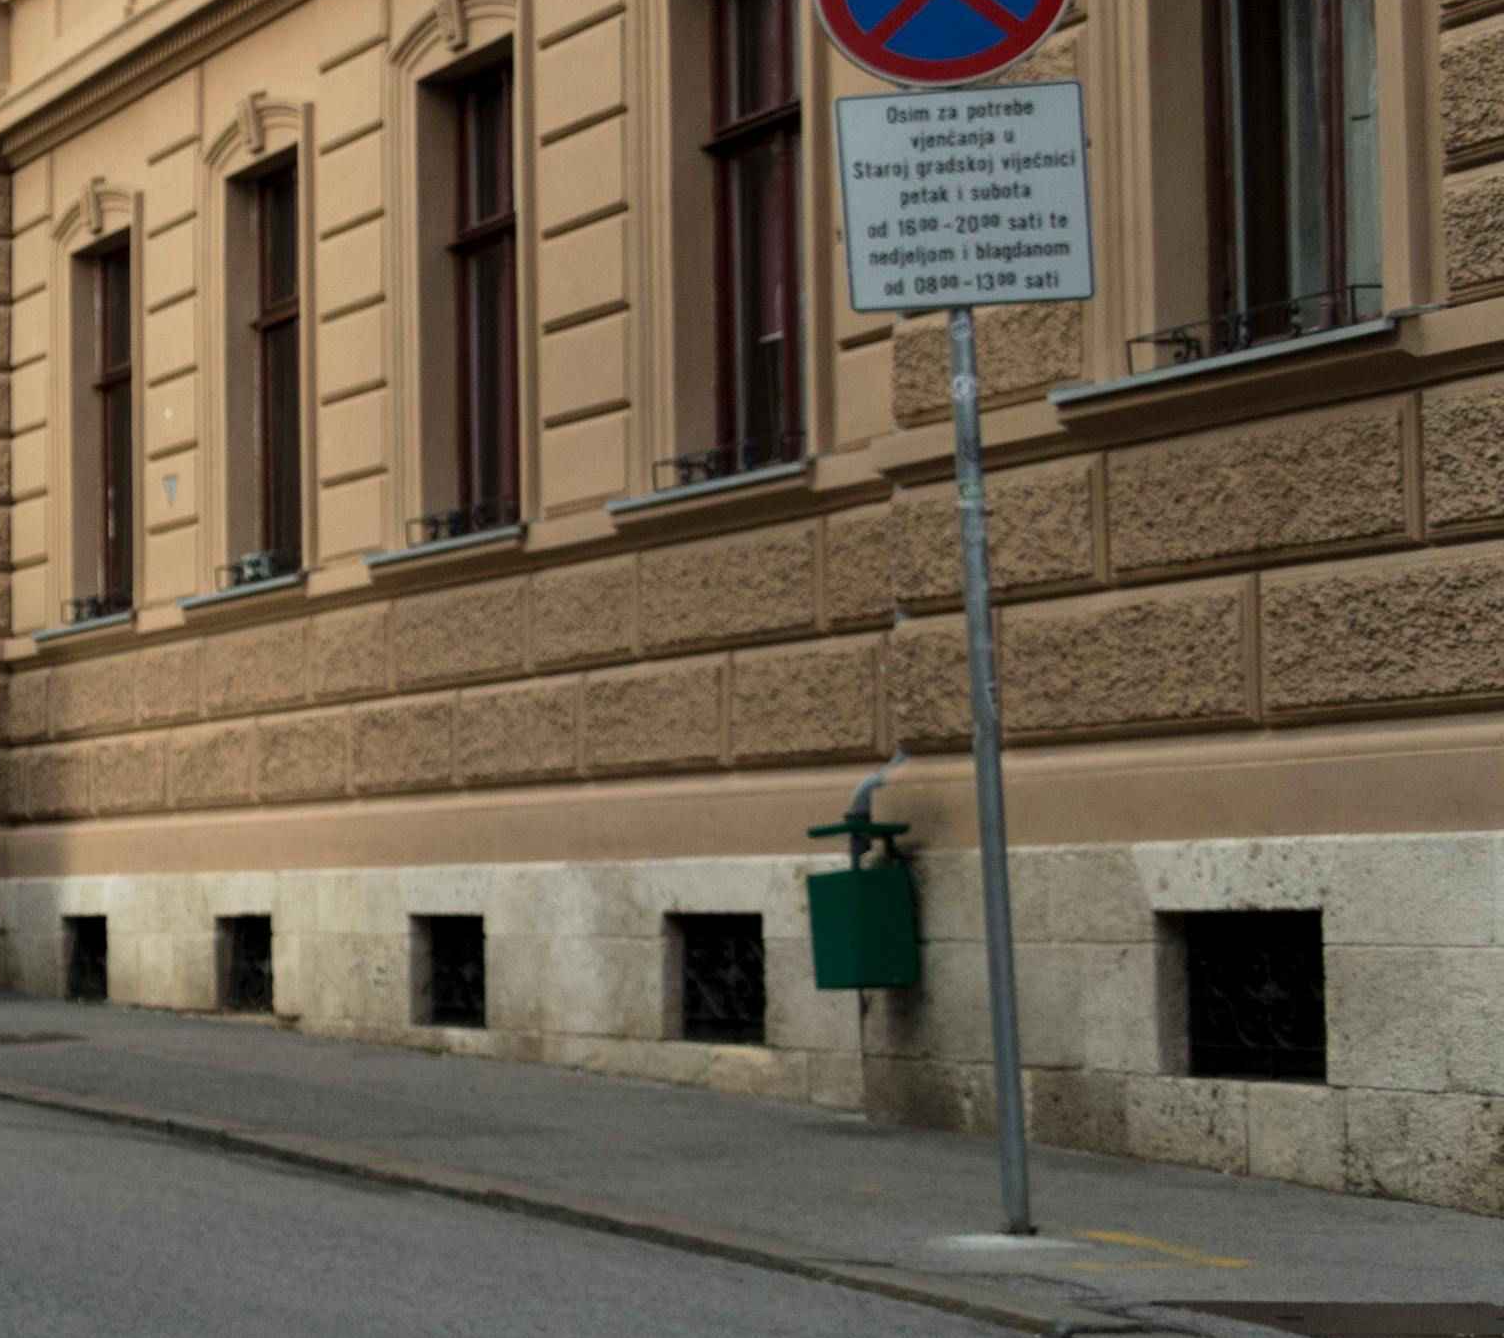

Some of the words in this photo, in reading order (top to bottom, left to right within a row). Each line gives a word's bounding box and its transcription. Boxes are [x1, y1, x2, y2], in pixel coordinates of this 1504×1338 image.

[886, 106, 930, 124] Osim
[937, 106, 957, 120] za
[967, 99, 1034, 121] potrebe
[1003, 129, 1014, 143] u
[853, 159, 909, 180] Staroj
[915, 154, 994, 178] gradskoj
[900, 185, 948, 208] petak
[970, 181, 1031, 200] subota
[867, 221, 887, 239] od
[1007, 212, 1042, 231] sati
[1049, 211, 1068, 229] te
[868, 245, 954, 267] nedjeljom
[975, 240, 1070, 262] blagdanom
[884, 278, 904, 296] od
[1024, 269, 1059, 289] sati
